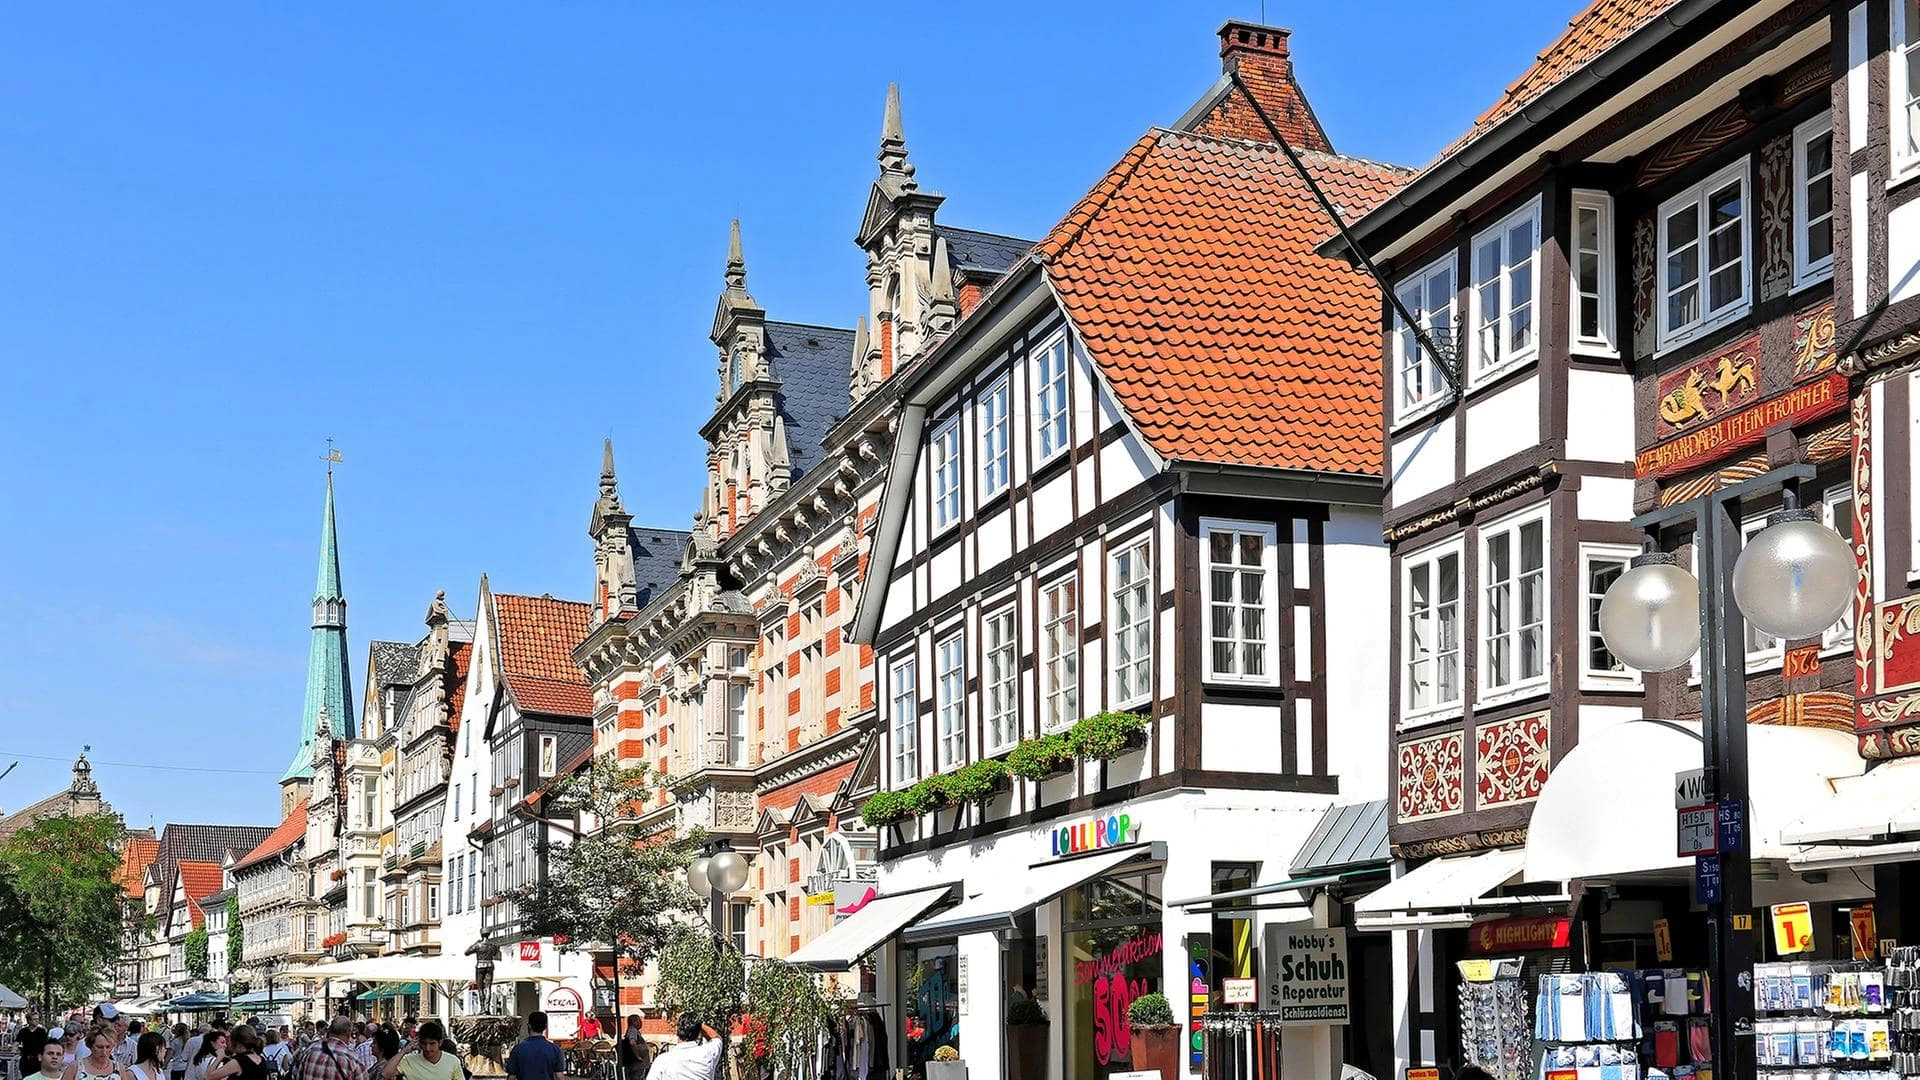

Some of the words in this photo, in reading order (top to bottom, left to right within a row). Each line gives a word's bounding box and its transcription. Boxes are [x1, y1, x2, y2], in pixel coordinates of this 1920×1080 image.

[1682, 811, 1705, 826] H150
[1052, 814, 1130, 856] LOLLIPOP
[1738, 916, 1747, 928] 17
[1496, 922, 1558, 944] HIGHLIGHTS
[521, 945, 539, 959] illy
[1282, 953, 1345, 982] Schuh
[1282, 984, 1345, 1003] Reparatur
[1283, 1005, 1346, 1018] Schlüsseldienst
